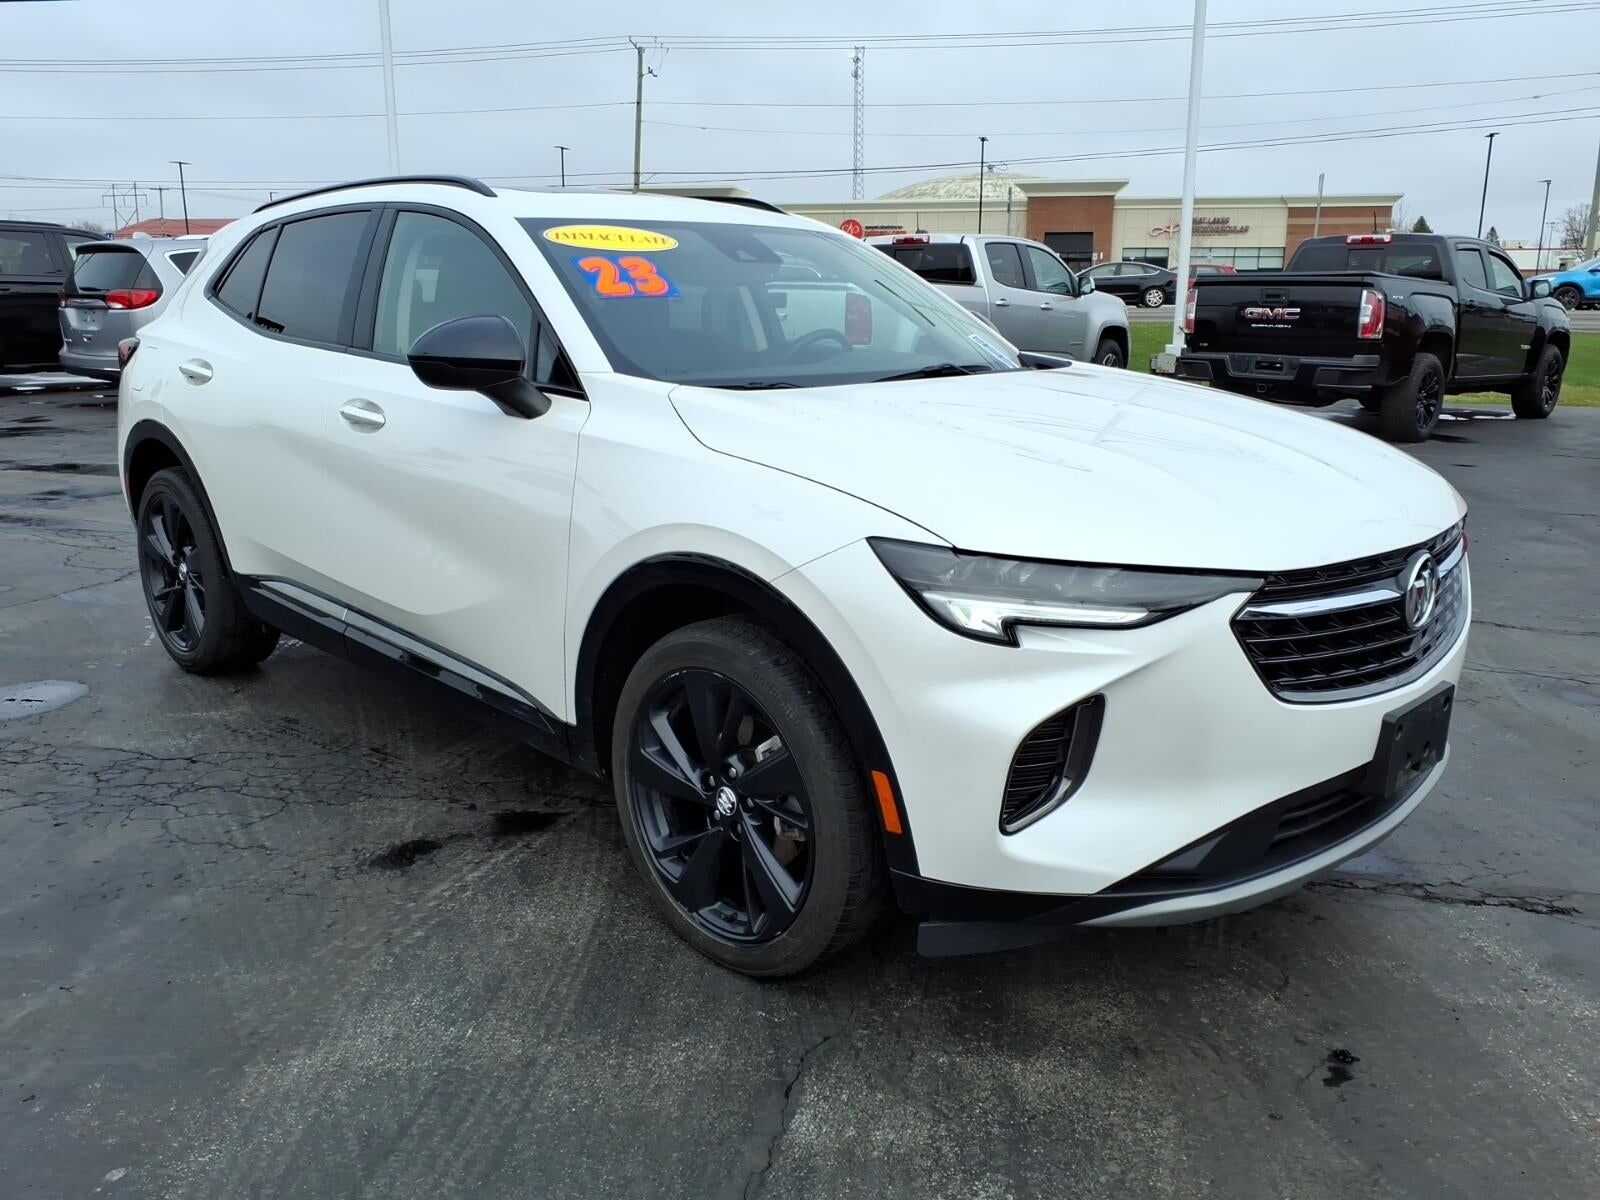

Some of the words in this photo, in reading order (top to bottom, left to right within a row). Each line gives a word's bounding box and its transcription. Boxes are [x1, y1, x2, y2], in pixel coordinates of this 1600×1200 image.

[554, 232, 669, 246] IMMACULATE
[578, 256, 669, 296] 23
[1245, 307, 1301, 320] GMC
